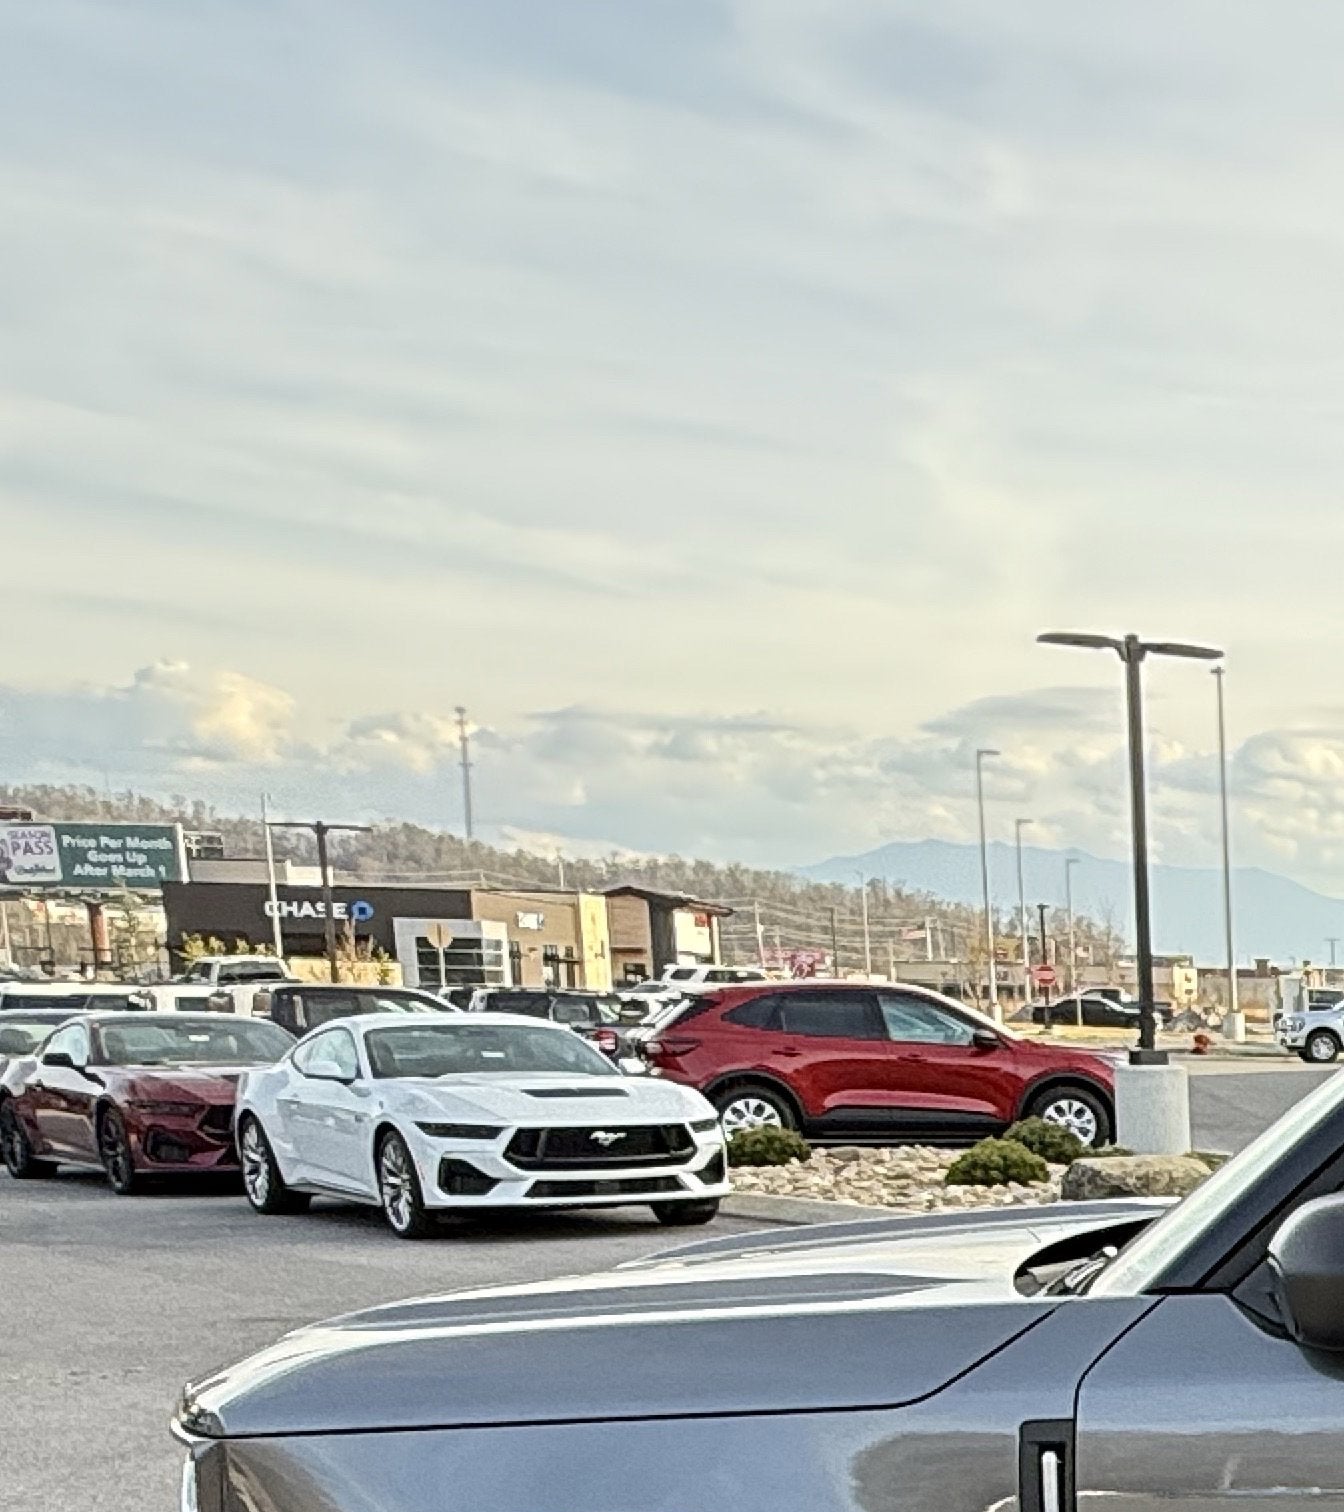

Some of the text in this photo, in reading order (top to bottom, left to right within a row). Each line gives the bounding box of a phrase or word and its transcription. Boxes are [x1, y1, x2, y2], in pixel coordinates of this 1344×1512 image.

[11, 840, 53, 855] PASS
[99, 835, 123, 848] Per
[125, 836, 173, 849] Month
[87, 850, 148, 865] Goes Up
[72, 863, 108, 876] After
[110, 864, 155, 877] March
[264, 900, 349, 919] CHASE
